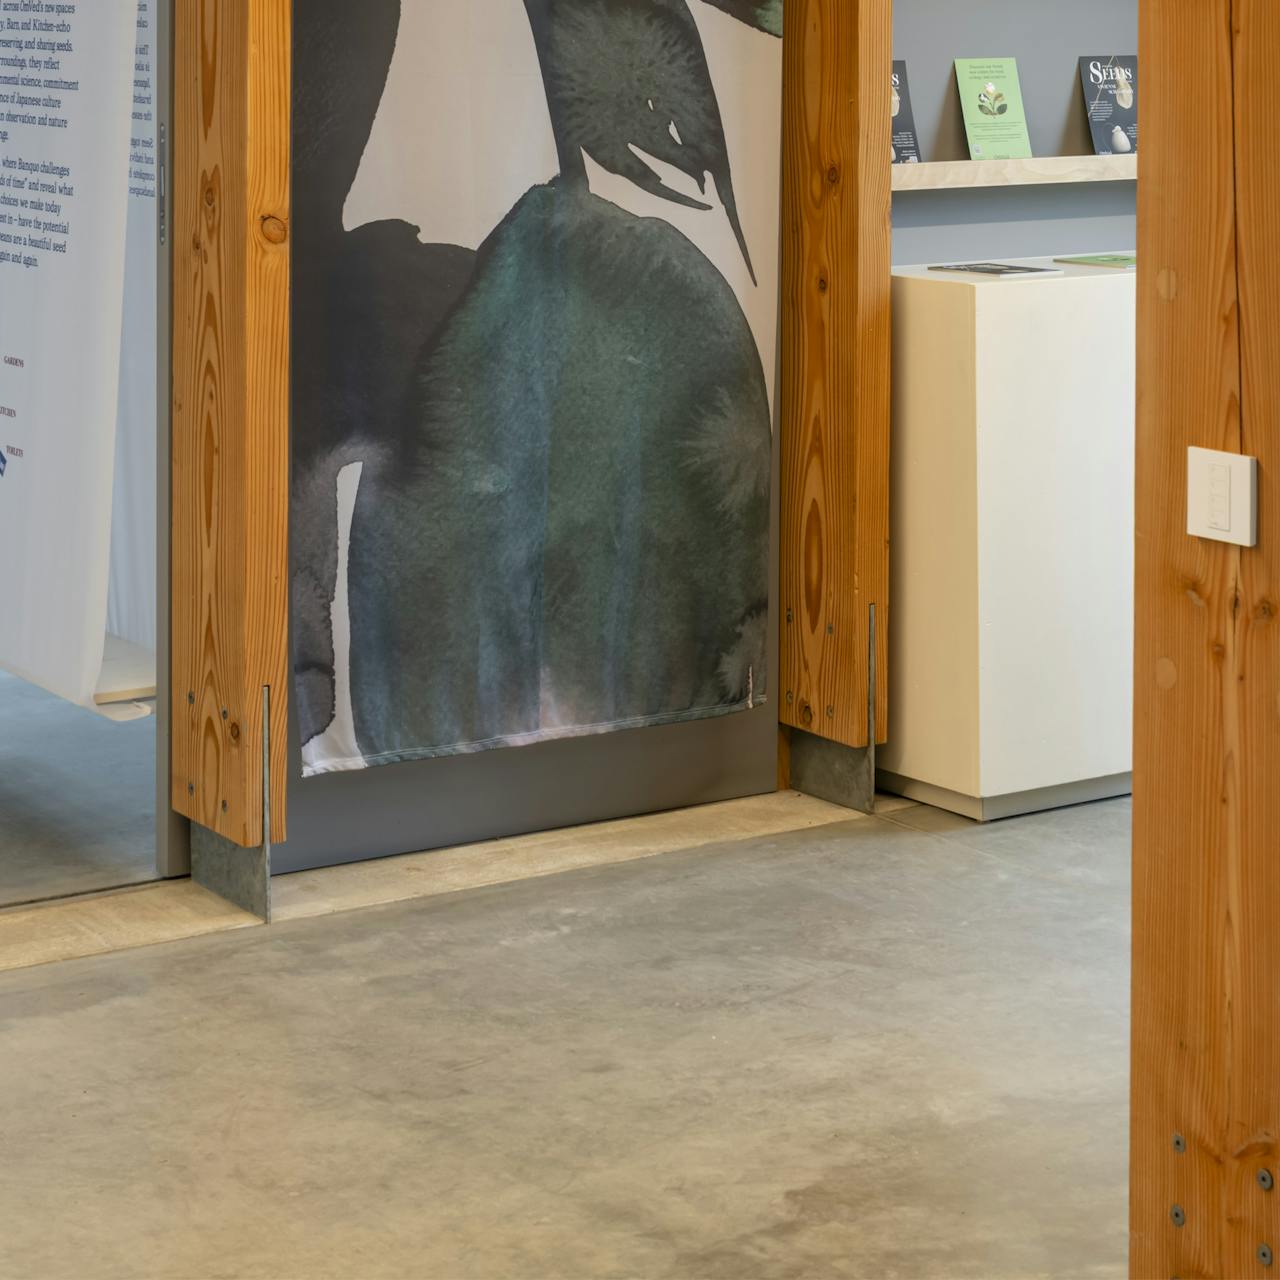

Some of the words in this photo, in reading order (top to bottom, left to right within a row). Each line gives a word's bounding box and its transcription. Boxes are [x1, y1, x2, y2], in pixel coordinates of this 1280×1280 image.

[56, 5, 75, 16] spaces
[25, 37, 35, 49] and
[29, 56, 41, 71] they
[1090, 61, 1132, 84] SEEDS
[16, 92, 41, 107] Japanese
[2, 156, 16, 169] where
[40, 161, 69, 179] challenges
[29, 179, 39, 191] and
[40, 181, 57, 193] reveal
[58, 183, 73, 196] what
[0, 192, 18, 207] choices
[20, 199, 28, 208] we
[30, 198, 43, 211] make
[45, 200, 61, 216] today
[19, 214, 32, 228] have
[43, 222, 69, 234] potential
[13, 236, 22, 245] are
[53, 241, 66, 253] seed
[12, 252, 22, 264] and
[4, 355, 24, 368] GARDENS
[6, 445, 24, 457] TOILETS
